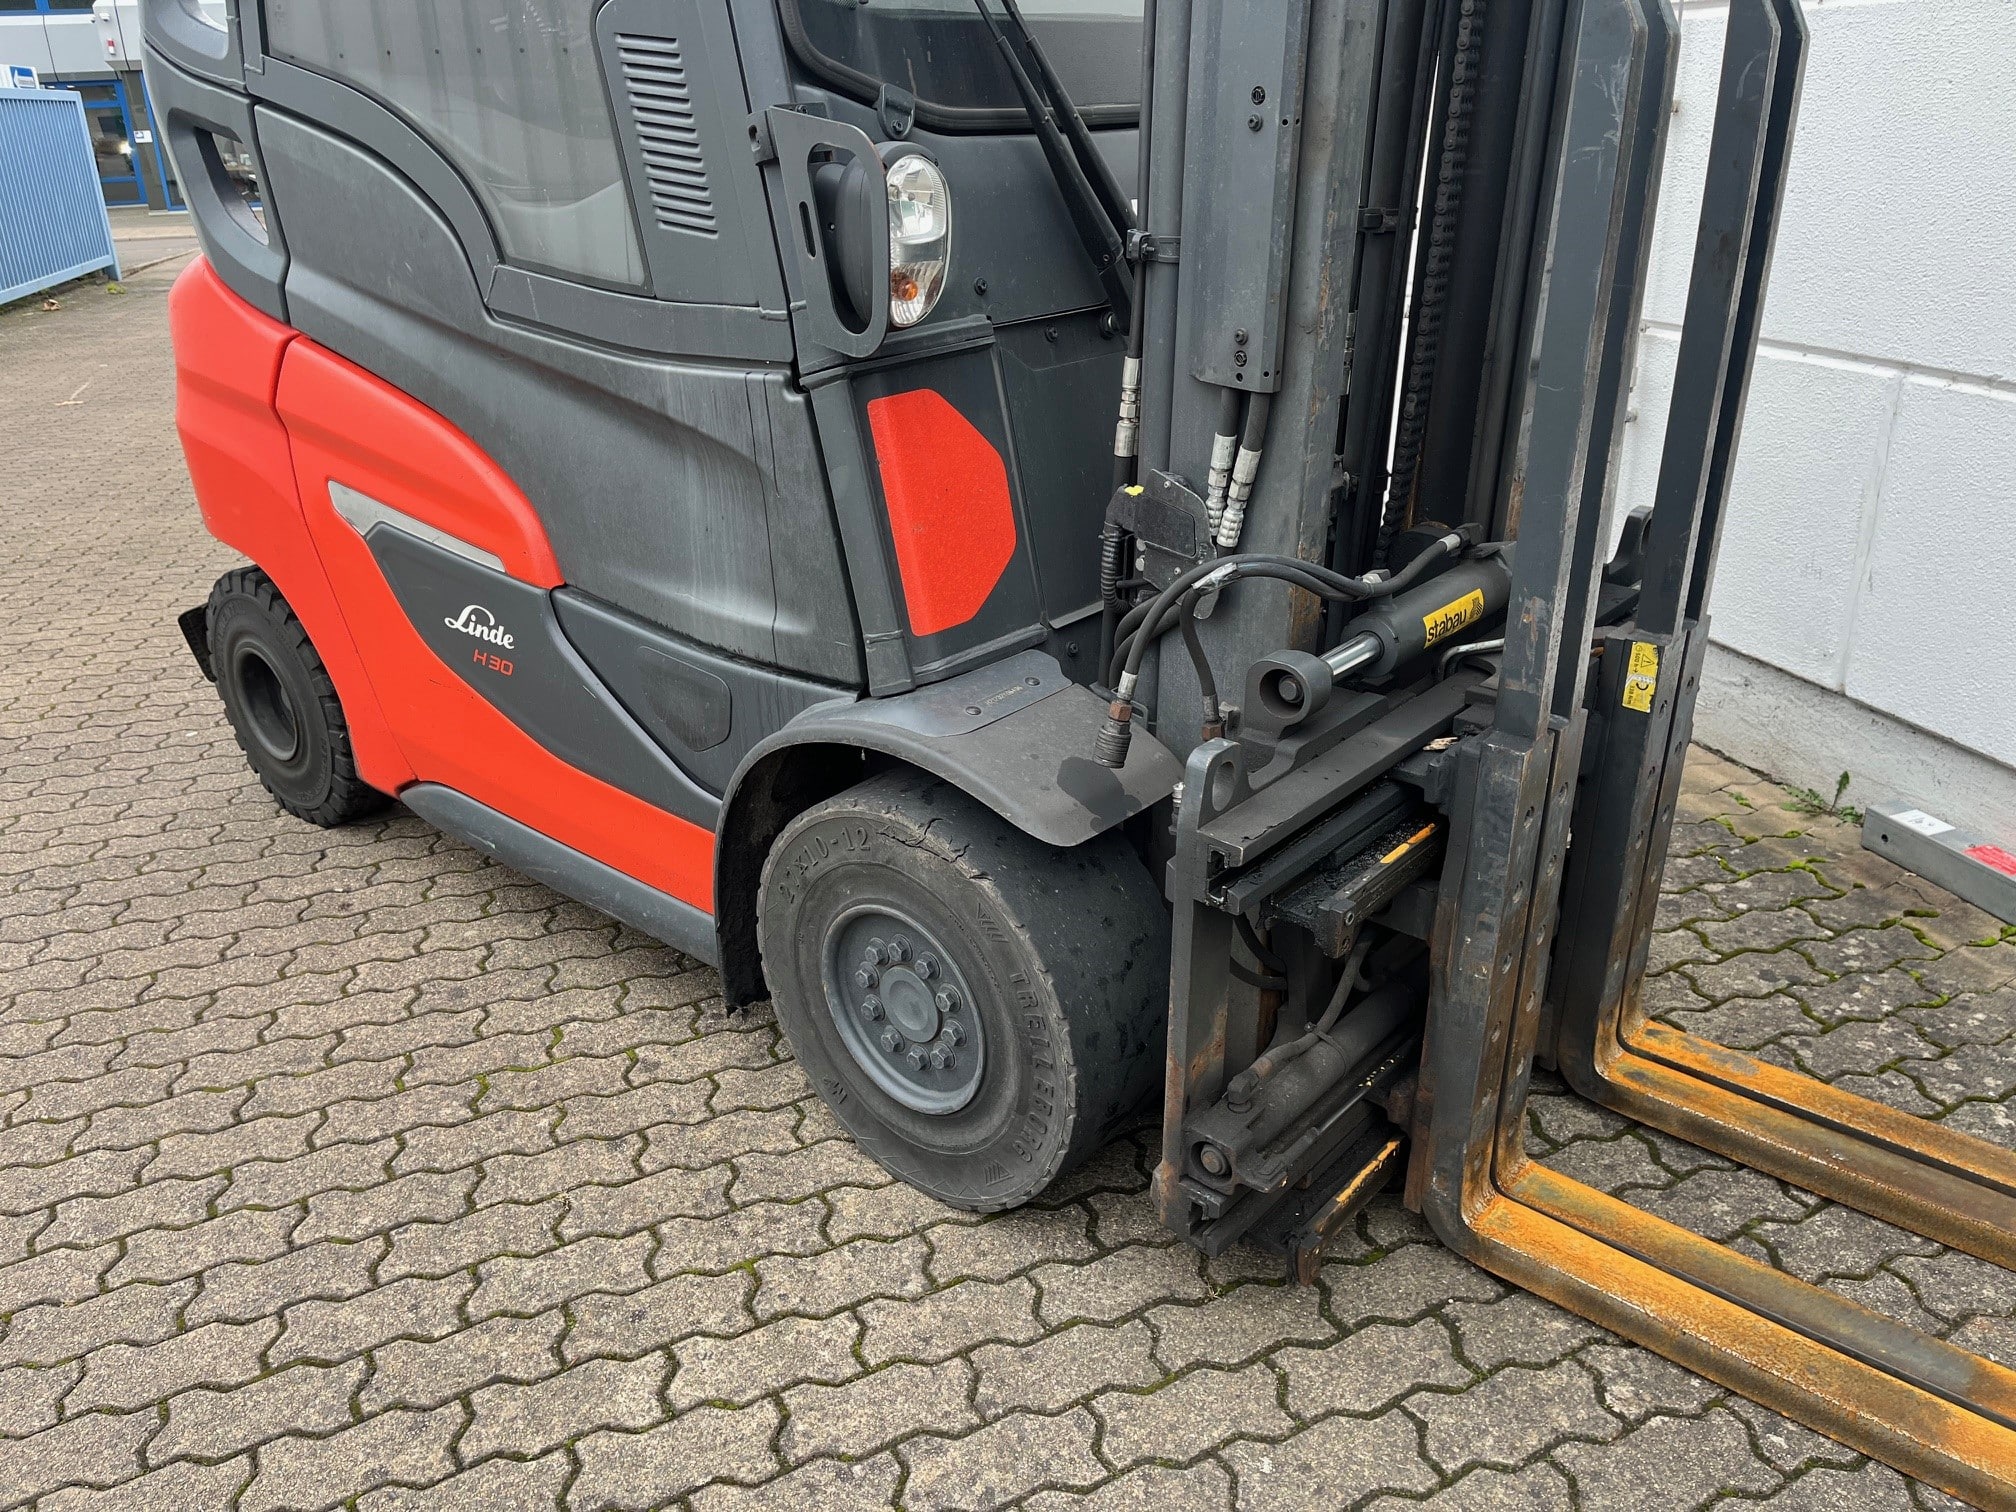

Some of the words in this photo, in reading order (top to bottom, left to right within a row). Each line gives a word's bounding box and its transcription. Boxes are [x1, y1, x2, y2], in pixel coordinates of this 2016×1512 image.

[444, 604, 515, 650] Linde
[1427, 608, 1467, 643] stabau
[1009, 968, 1056, 1163] TRELLEBORG
